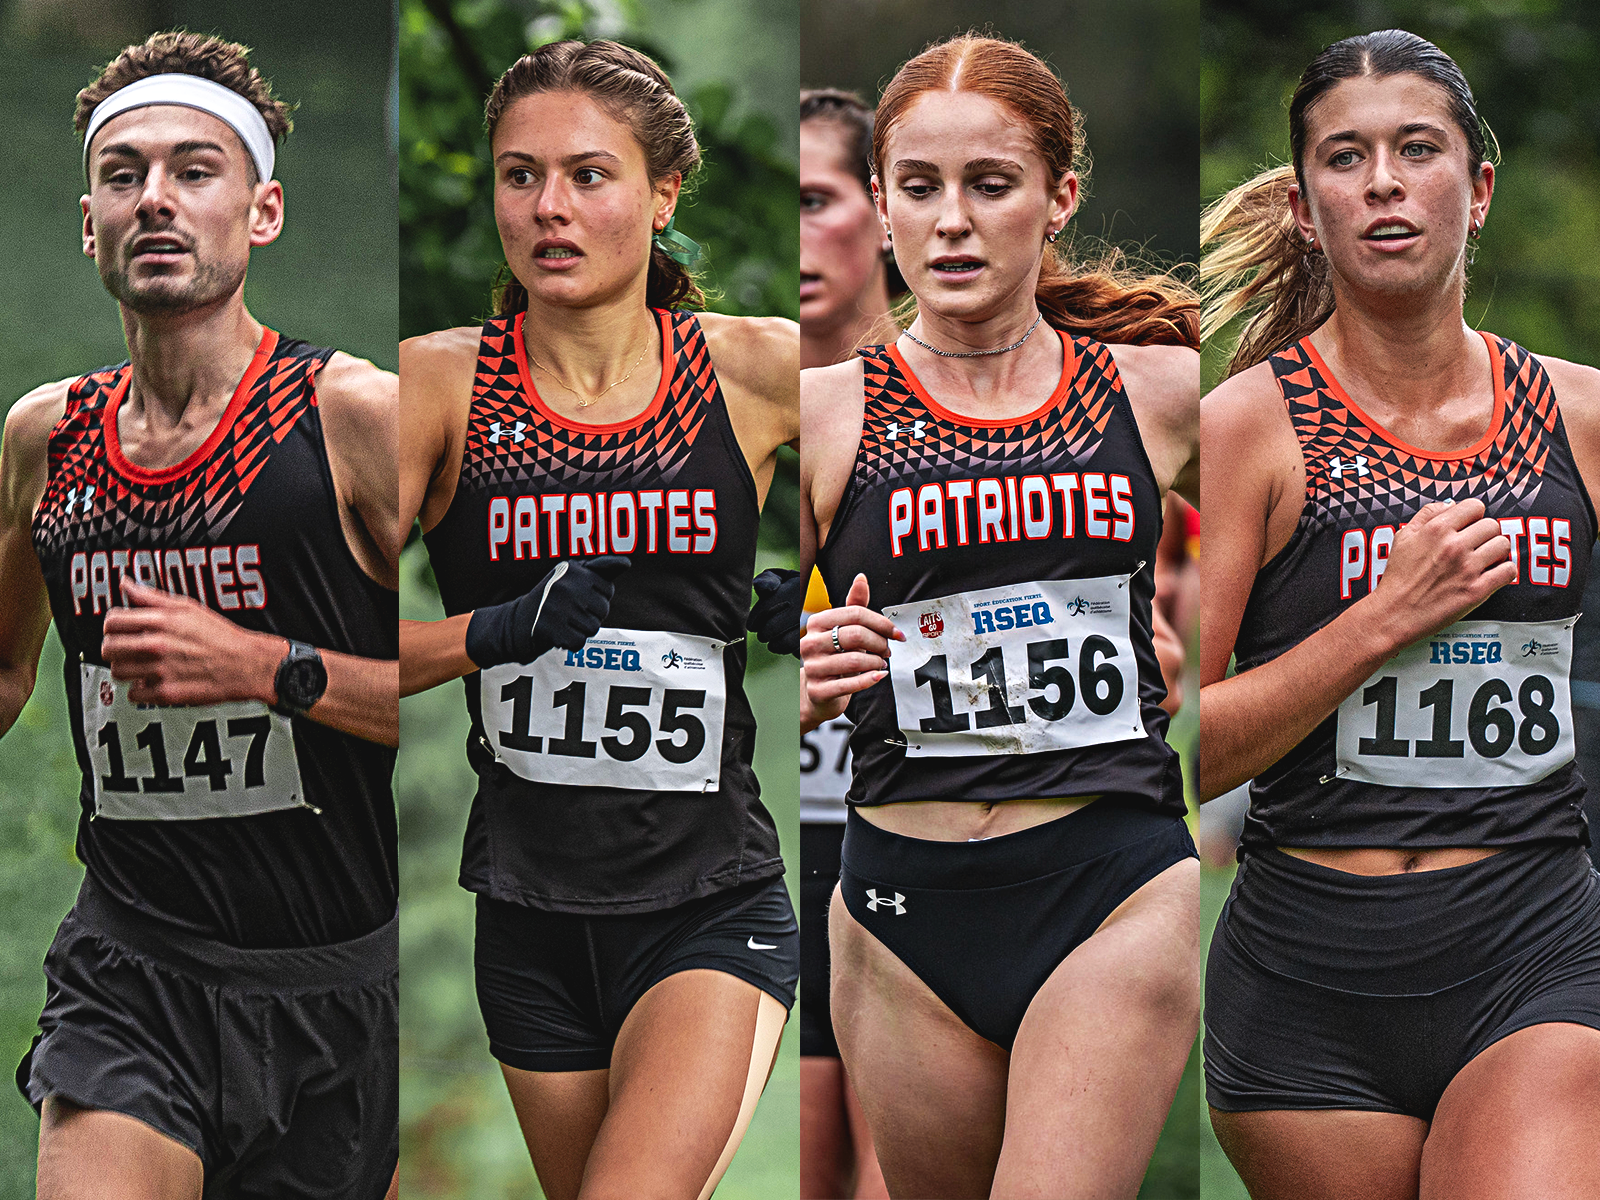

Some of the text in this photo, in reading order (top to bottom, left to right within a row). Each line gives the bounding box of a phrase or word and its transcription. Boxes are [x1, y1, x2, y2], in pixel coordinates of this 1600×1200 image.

[488, 489, 718, 561] PATRIOTES
[887, 472, 1135, 558] PATRIOTES
[1340, 516, 1573, 600] PATES
[971, 601, 1055, 635] RSEQ
[1429, 641, 1503, 665] RSEQ
[564, 647, 643, 672] RSEQ
[913, 634, 1124, 733] 1156
[98, 714, 271, 793] 1147
[499, 674, 707, 764] 1155
[1358, 674, 1560, 759] 1168
